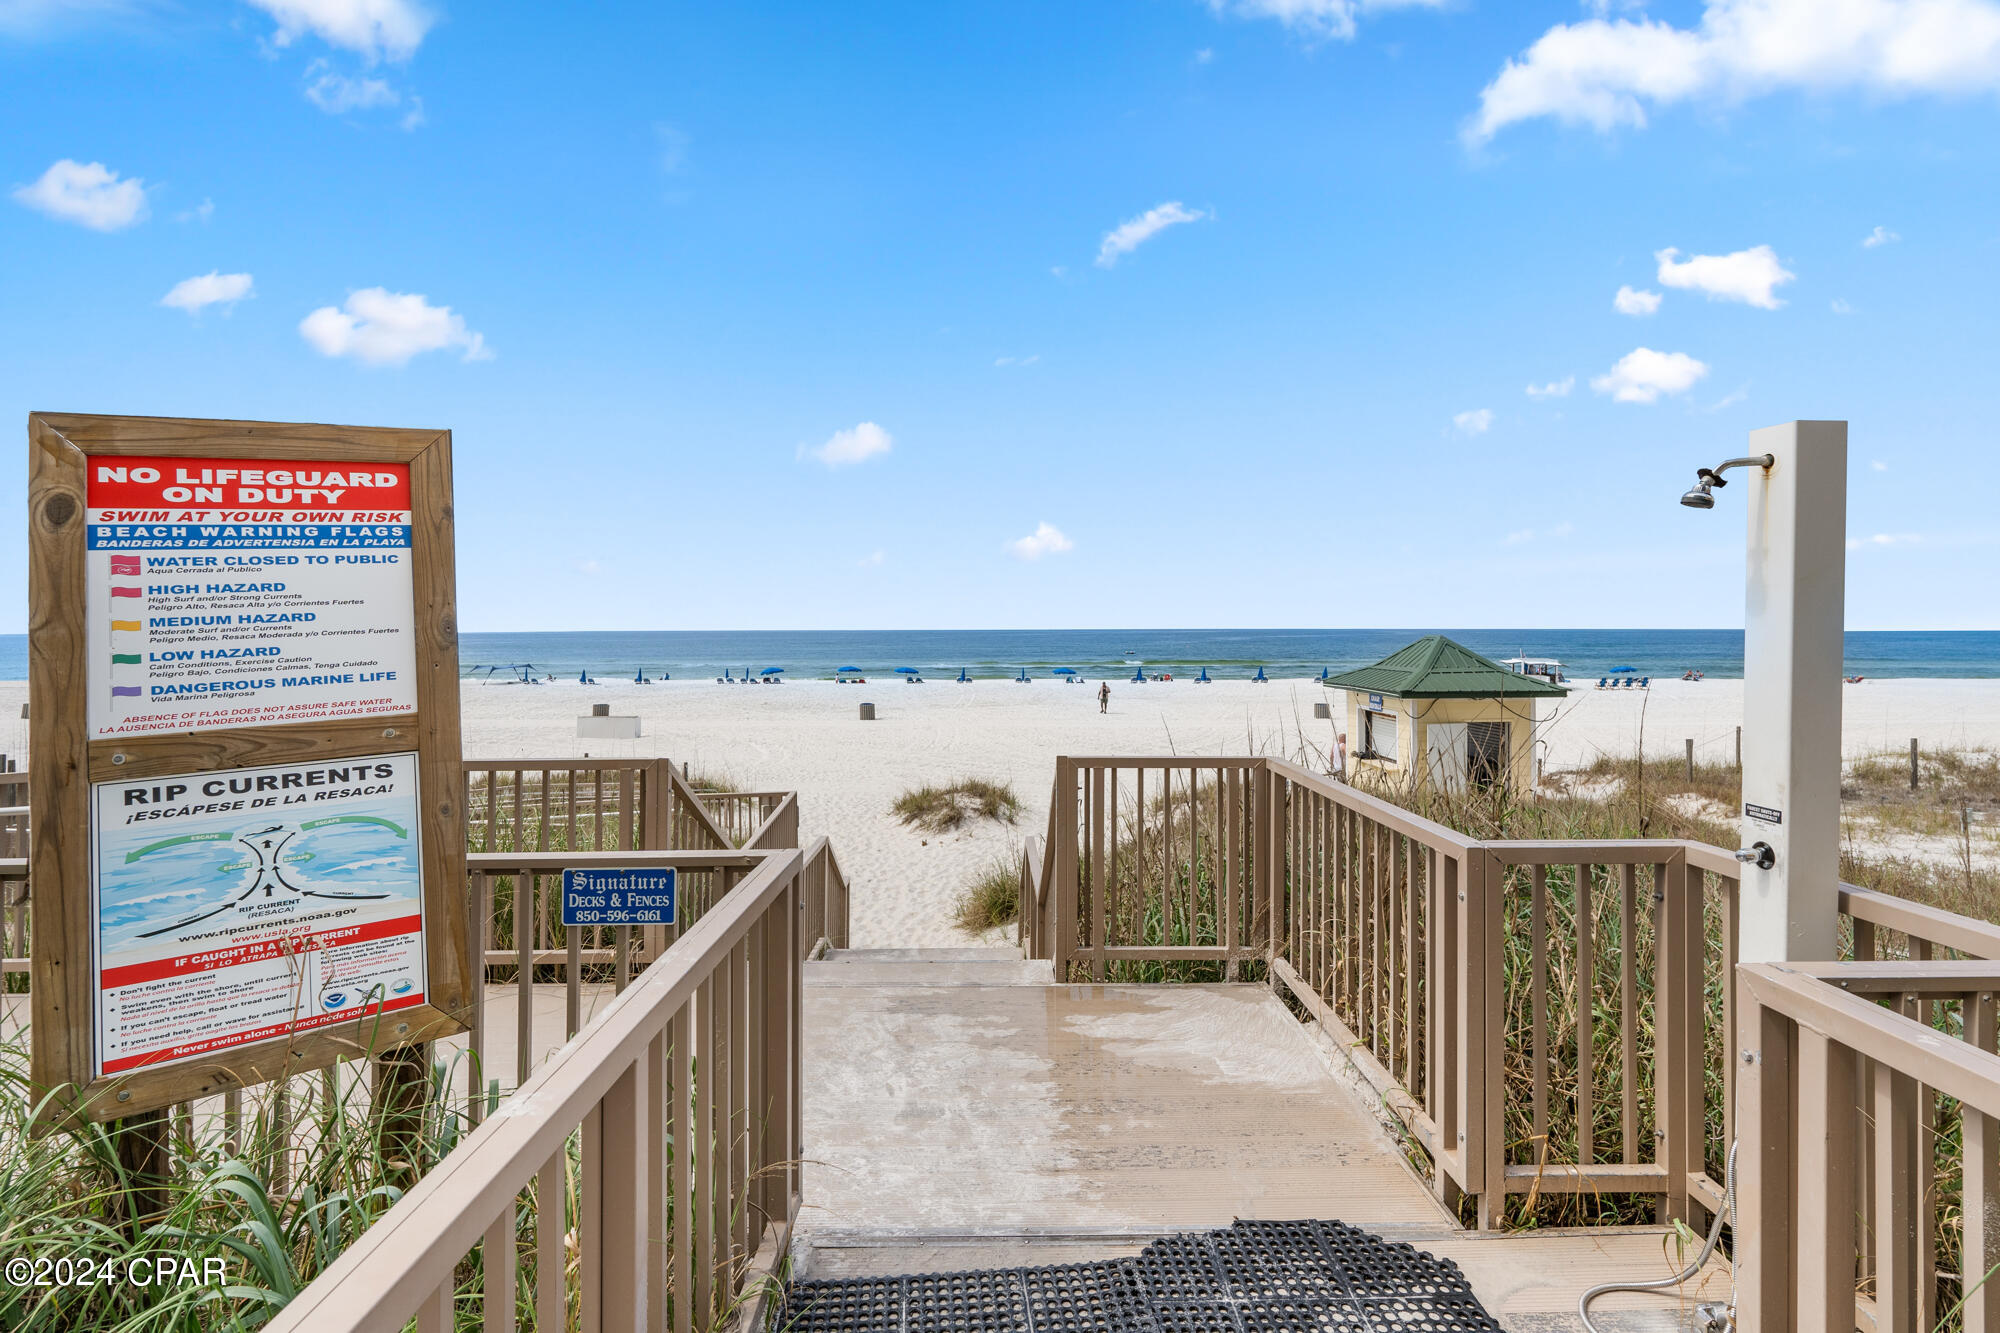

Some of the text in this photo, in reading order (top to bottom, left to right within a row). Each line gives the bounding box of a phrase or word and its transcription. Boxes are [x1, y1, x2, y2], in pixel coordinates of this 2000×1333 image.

[98, 467, 398, 488] NO LIFEGUARD
[162, 487, 345, 504] ON DUTY
[99, 511, 403, 523] SWIM AT YOUR OWN RISK
[97, 527, 403, 537] BEACH WARNING FLAGS
[96, 539, 183, 548] BANDERAS
[212, 539, 315, 547] ADVERTENSIA
[147, 554, 398, 567] WATER CLOSED TO PUBLIC
[148, 583, 286, 595] HIGH HAZARD
[149, 612, 316, 628] MEDIUM HAZARD
[149, 647, 281, 662] LOW HAZARD
[151, 671, 396, 696] DANGEROUS MARINE LIFE
[116, 722, 176, 733] AUSENCIA
[197, 716, 256, 726] BANDERAS
[277, 711, 326, 720] ASEGURA
[329, 708, 363, 716] AGUAS
[366, 704, 411, 713] SEGURAS
[123, 713, 178, 724] ABSENCE
[199, 710, 228, 718] FLAG
[231, 707, 261, 716] DOES
[287, 702, 328, 711] ASSURE
[124, 764, 393, 806] RIP CURRENTS
[126, 784, 394, 825] ¡ESCÁPESE DE LA RESACA!
[314, 818, 340, 826] ESCAPE
[283, 854, 310, 862] ESCAPE
[224, 862, 252, 870] ESCAPE
[571, 872, 667, 894] Signature
[257, 898, 300, 910] CURRENT
[247, 906, 295, 919] (RESACA)
[576, 910, 661, 922] 850-596-6161
[179, 906, 357, 943] www.ripcurrents.noaa.gov
[232, 924, 311, 944] www.usla.org
[175, 958, 187, 967] IF
[191, 947, 246, 964] CAUGHT
[250, 944, 264, 954] IN
[267, 942, 276, 953] A
[240, 951, 279, 963] ATRAPA
[184, 974, 216, 984] current
[121, 1002, 147, 1010] Swim
[244, 978, 263, 986] until
[266, 971, 298, 982] current
[229, 986, 254, 994] shore
[208, 1005, 227, 1013] float
[240, 998, 262, 1006] tread
[149, 1032, 170, 1041] need
[173, 1043, 209, 1055] Never
[211, 1036, 242, 1047] swim
[244, 1028, 276, 1040] alone
